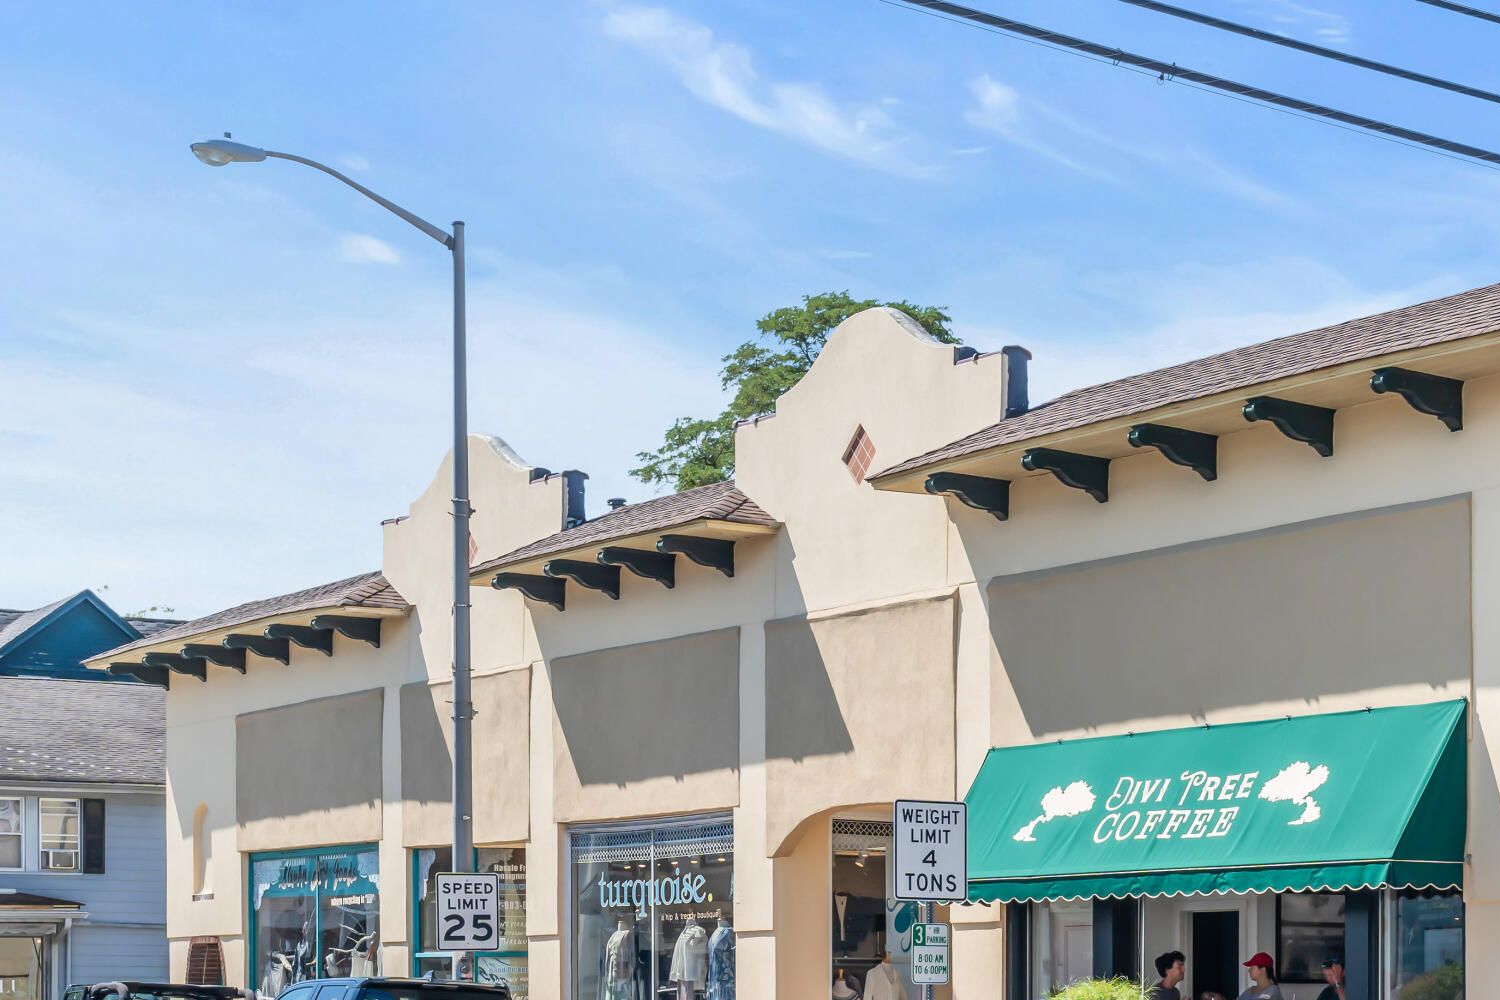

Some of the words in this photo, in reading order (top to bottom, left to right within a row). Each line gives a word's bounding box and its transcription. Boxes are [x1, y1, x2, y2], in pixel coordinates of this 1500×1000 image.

[1105, 776, 1172, 811] DIVI
[1178, 770, 1259, 806] TREE
[902, 808, 960, 825] WEIGHT
[1093, 806, 1240, 844] COFFEE
[911, 828, 951, 844] LIMIT
[922, 850, 937, 867] 4
[442, 883, 494, 894] SPEED
[905, 873, 957, 893] TONS
[447, 899, 488, 910] LIMIT
[443, 914, 493, 942] 25
[915, 926, 923, 944] 3
[927, 936, 947, 944] PARKING
[918, 954, 933, 963] 8:00
[935, 954, 944, 963] AM
[915, 965, 922, 974] TO
